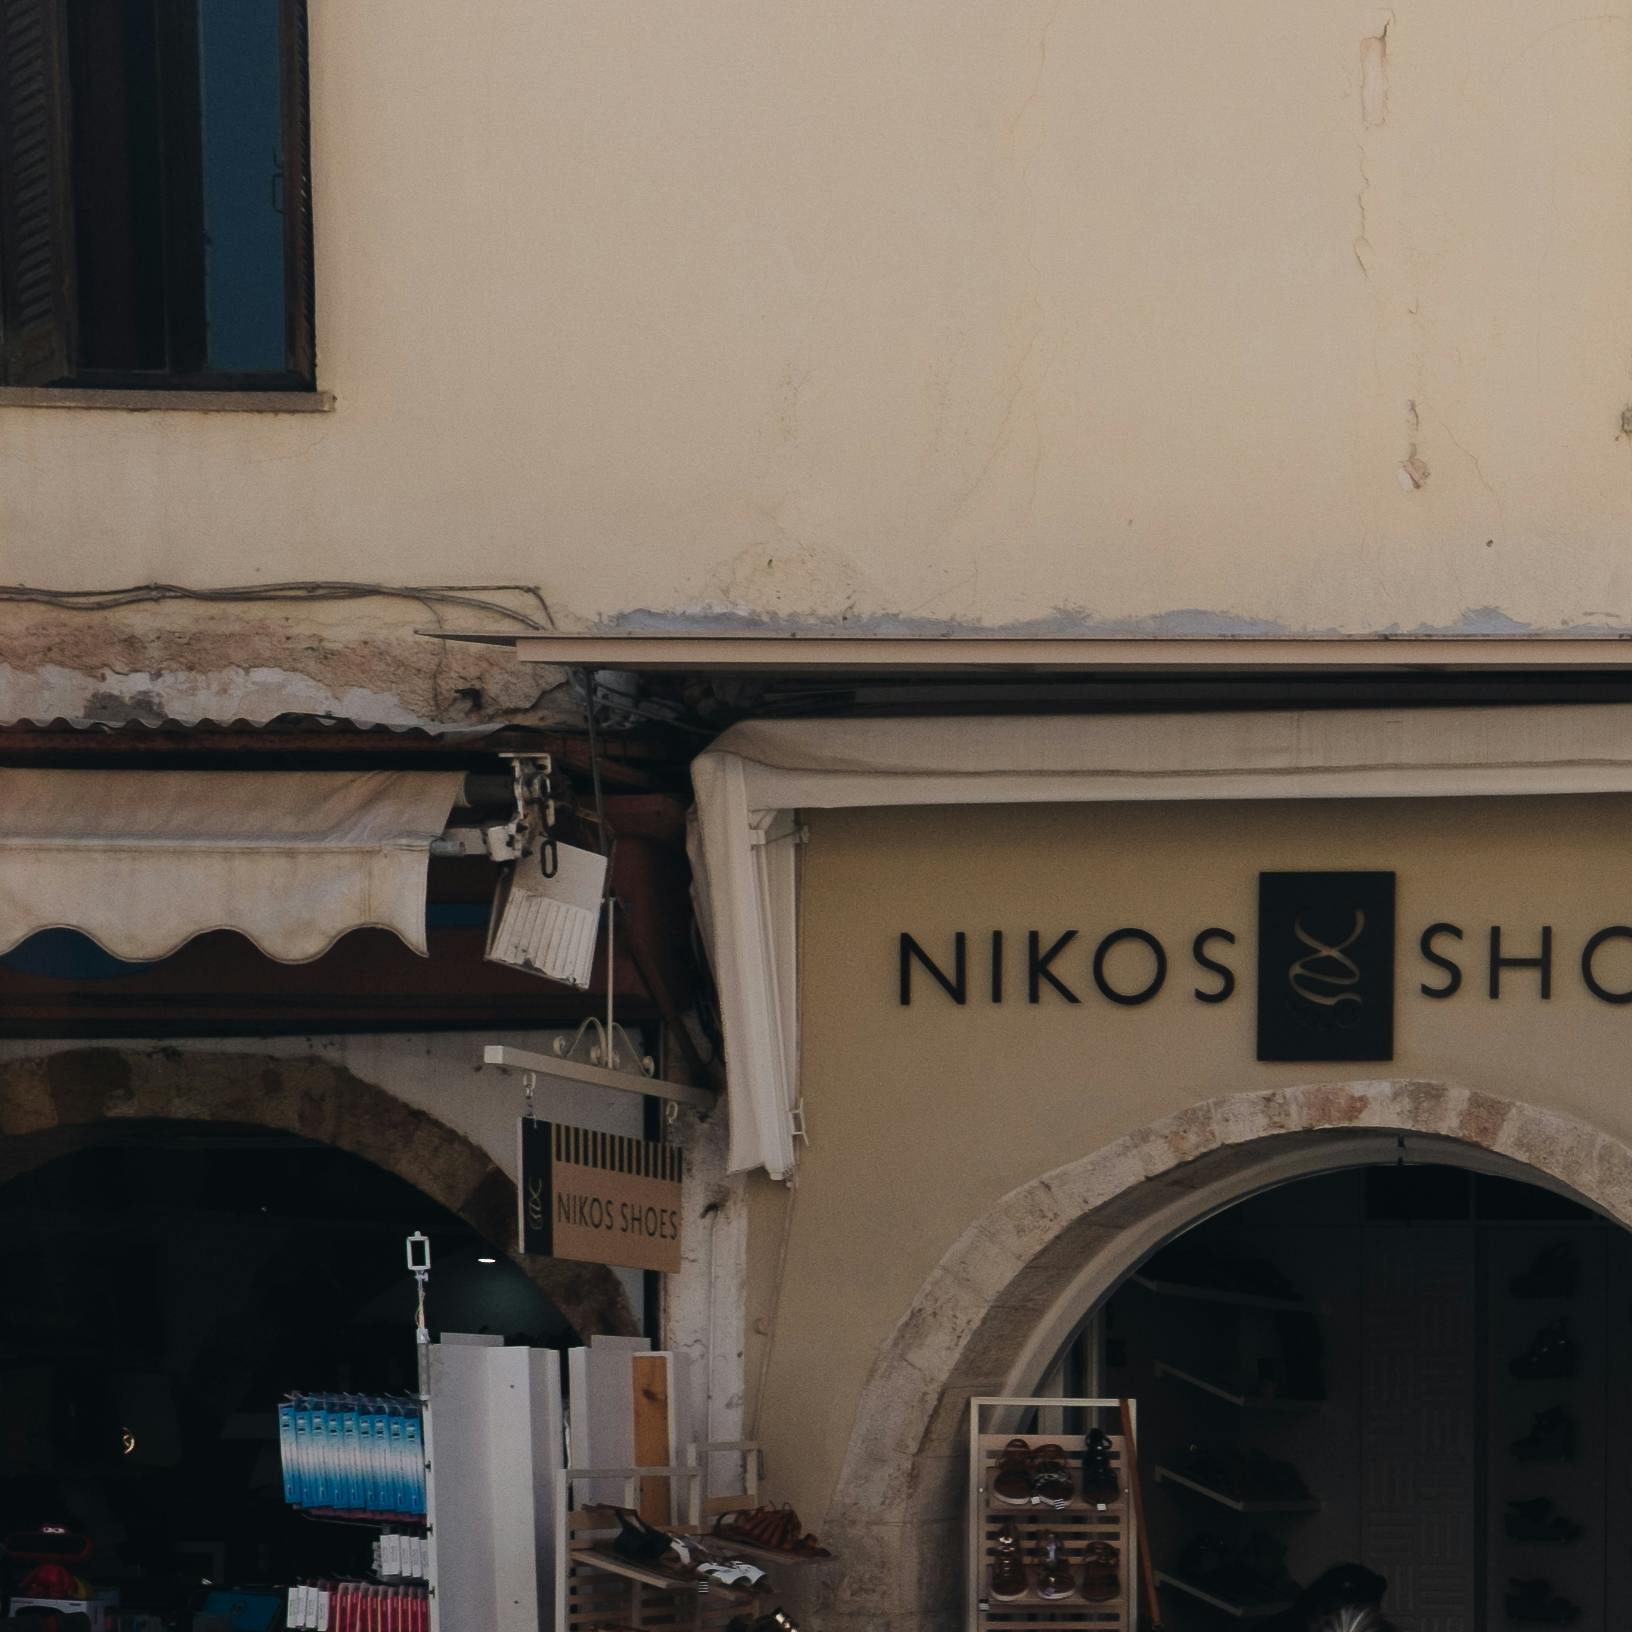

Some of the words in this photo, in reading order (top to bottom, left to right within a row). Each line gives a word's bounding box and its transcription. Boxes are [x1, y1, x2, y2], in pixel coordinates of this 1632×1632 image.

[899, 927, 1237, 1006] NIKOS
[557, 1191, 616, 1232] NIKOS
[619, 1202, 678, 1242] SHOES
